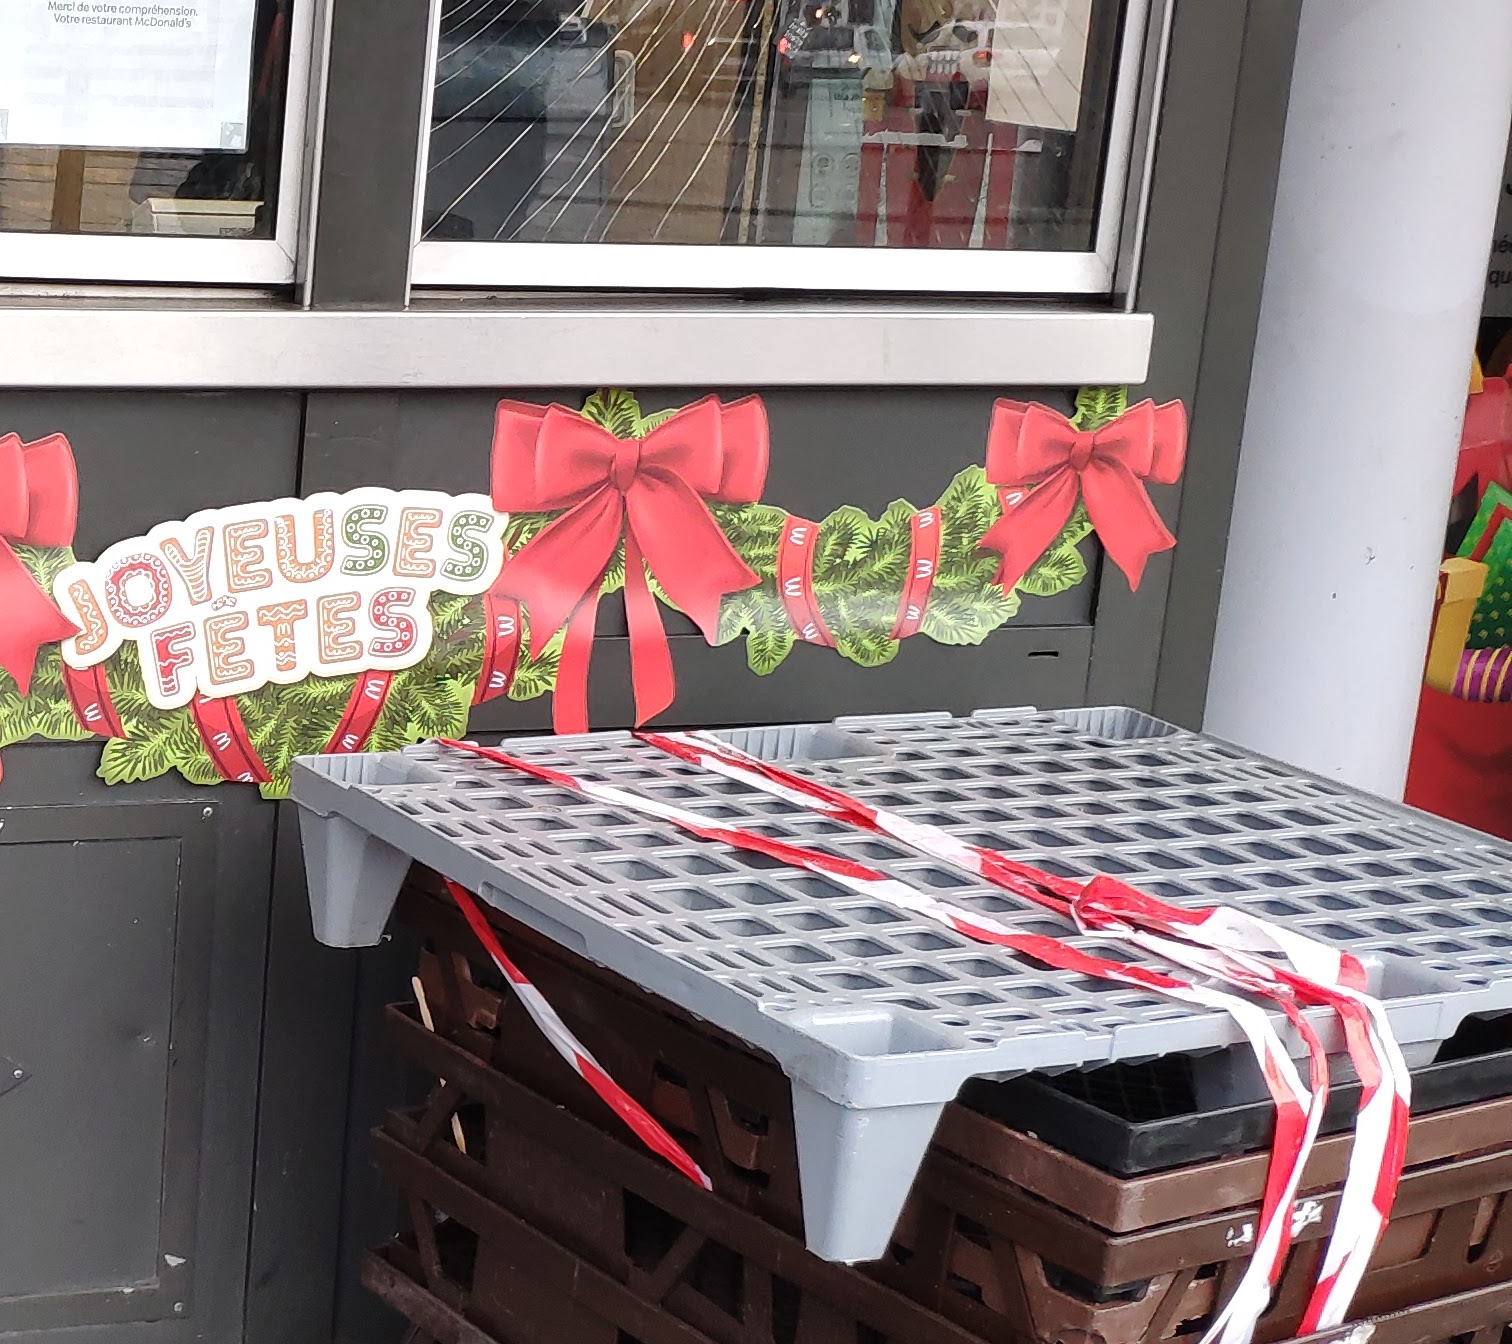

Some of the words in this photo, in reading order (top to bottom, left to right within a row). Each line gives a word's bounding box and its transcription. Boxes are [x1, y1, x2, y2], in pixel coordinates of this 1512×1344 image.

[47, 1, 76, 11] Merci
[77, 2, 90, 12] de
[91, 3, 117, 13] votre
[118, 4, 199, 18] compréhension.
[54, 12, 80, 23] Votre
[81, 14, 133, 26] restaurant
[135, 17, 192, 28] McDonald's
[68, 504, 498, 656] JOYEUSES
[150, 587, 418, 698] FÊTES
